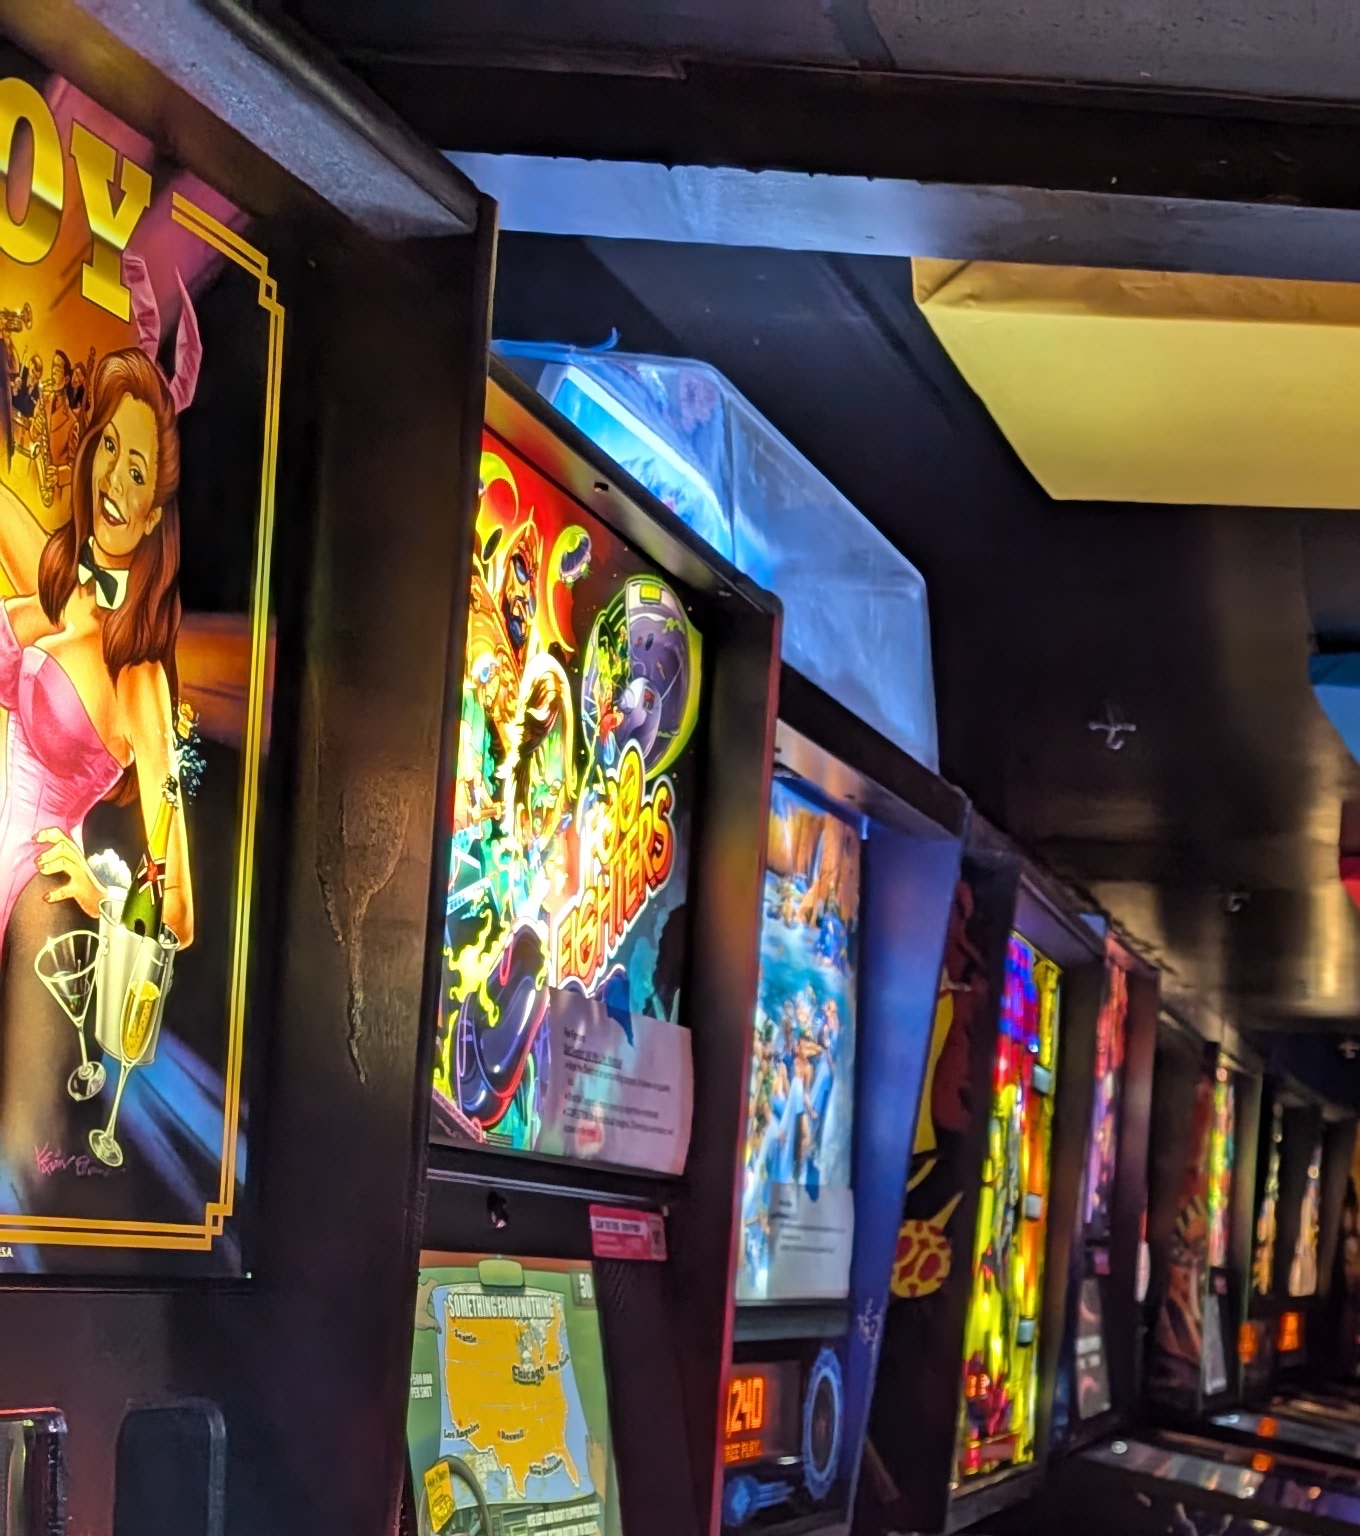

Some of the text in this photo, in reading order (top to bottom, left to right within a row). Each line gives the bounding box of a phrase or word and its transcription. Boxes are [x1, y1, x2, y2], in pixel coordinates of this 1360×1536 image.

[584, 750, 641, 884] FOO
[557, 786, 673, 986] FIGHTERS
[578, 1273, 593, 1298] 50
[448, 1294, 554, 1318] SOMETHING FROM NOTHING
[512, 1365, 545, 1381] Chicago
[456, 1423, 480, 1440] Angeles
[501, 1430, 524, 1441] Roswell
